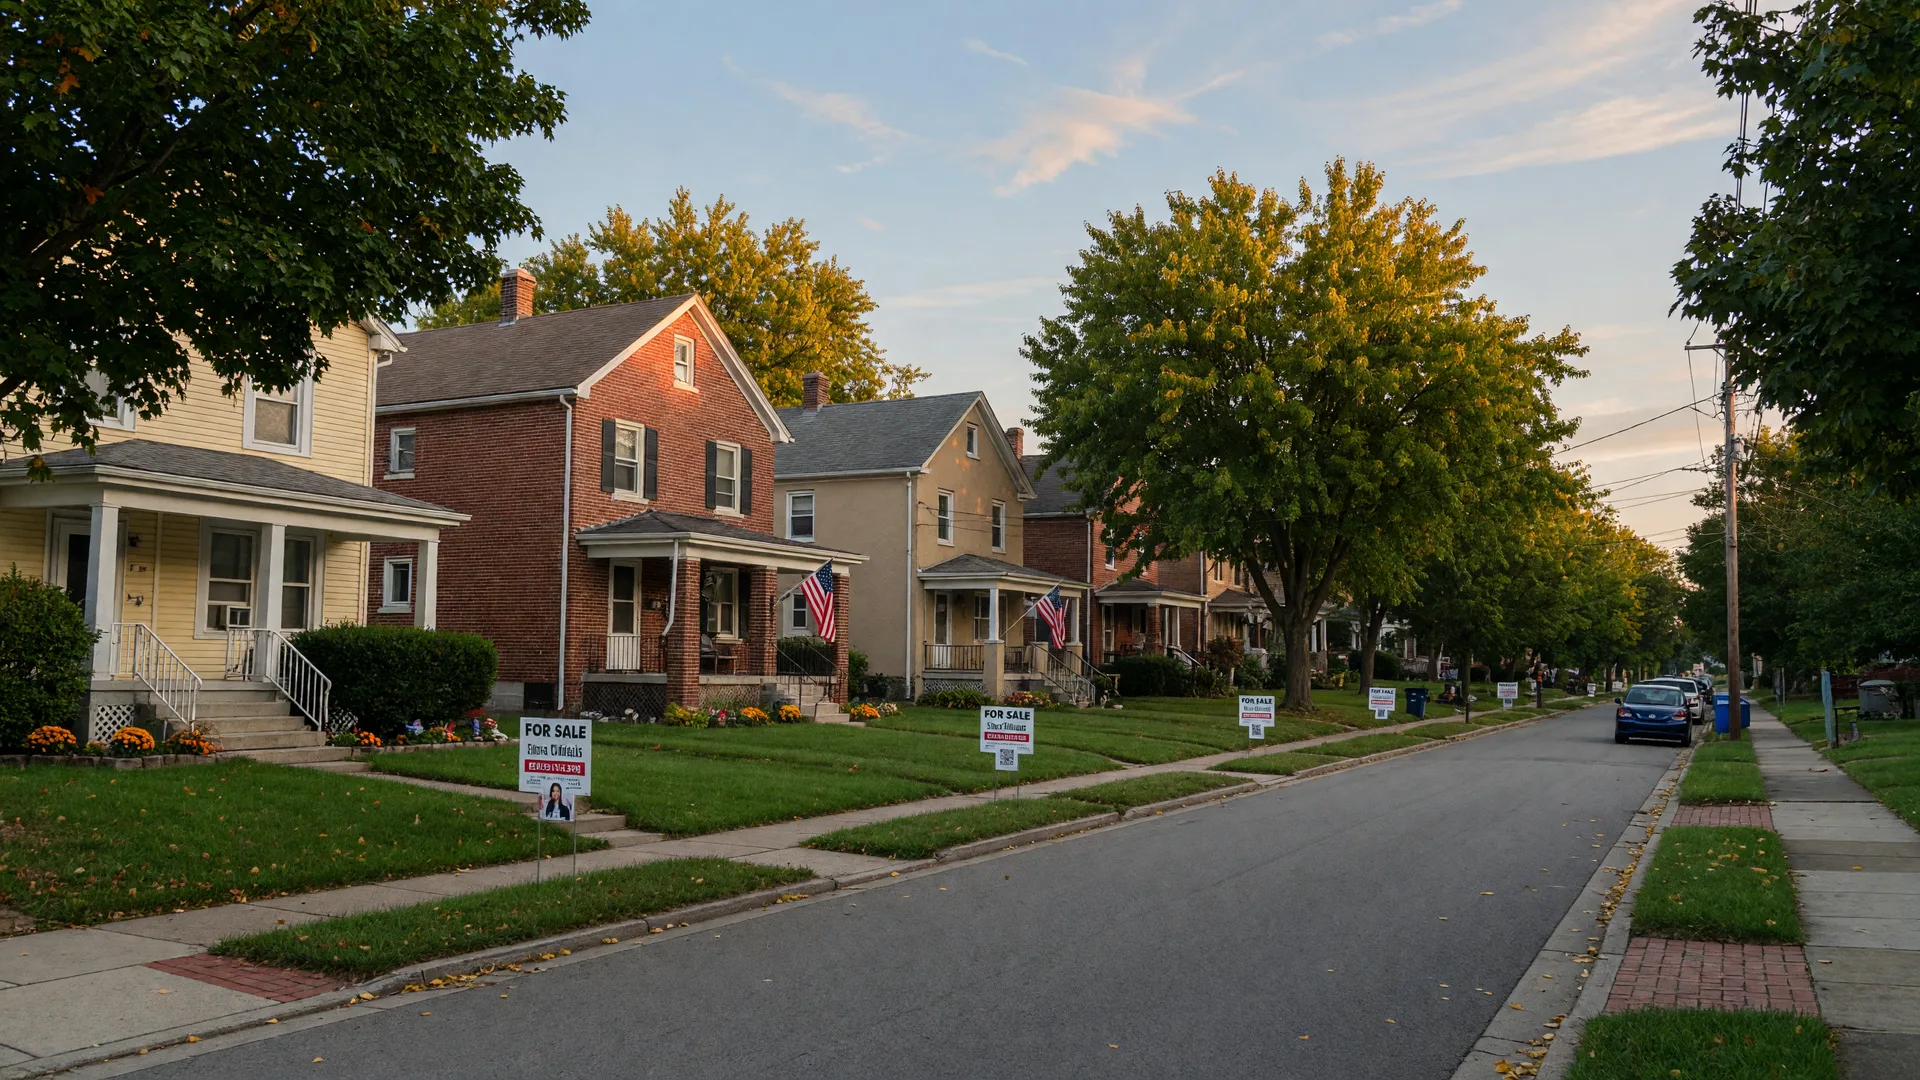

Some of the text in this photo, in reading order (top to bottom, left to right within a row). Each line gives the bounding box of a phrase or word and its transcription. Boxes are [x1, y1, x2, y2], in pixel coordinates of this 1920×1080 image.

[985, 710, 1030, 720] FOR SALE
[526, 723, 586, 739] FOR SALE
